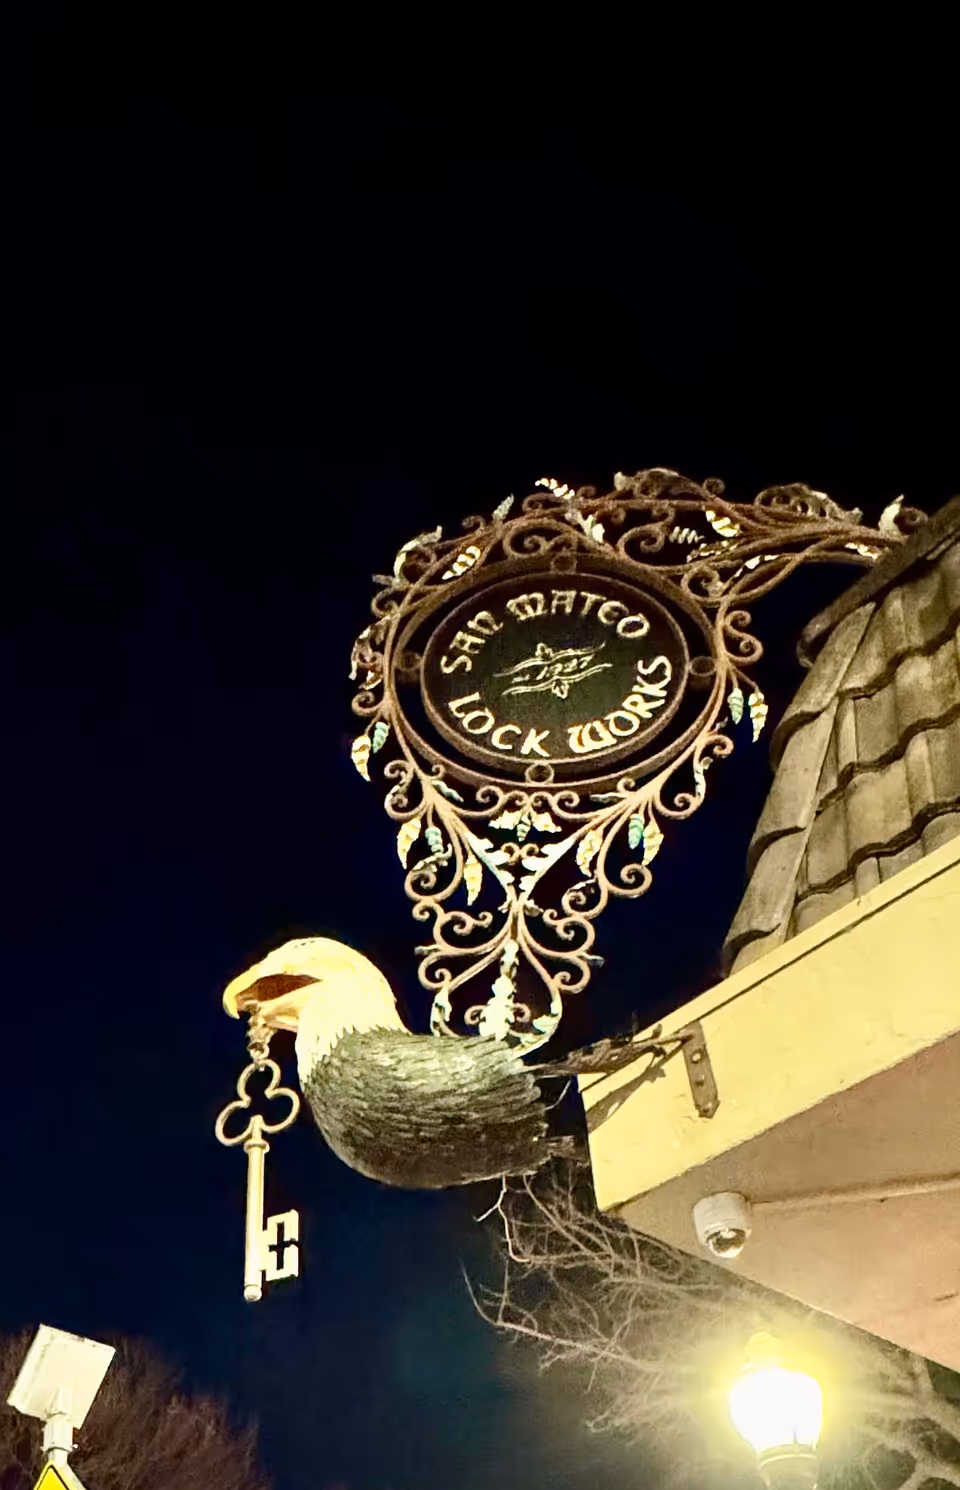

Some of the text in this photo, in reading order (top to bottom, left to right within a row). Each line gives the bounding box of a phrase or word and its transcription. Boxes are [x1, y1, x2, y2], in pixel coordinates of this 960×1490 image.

[440, 589, 650, 674] SAN MATEO
[448, 655, 673, 757] LOCK WORKS
